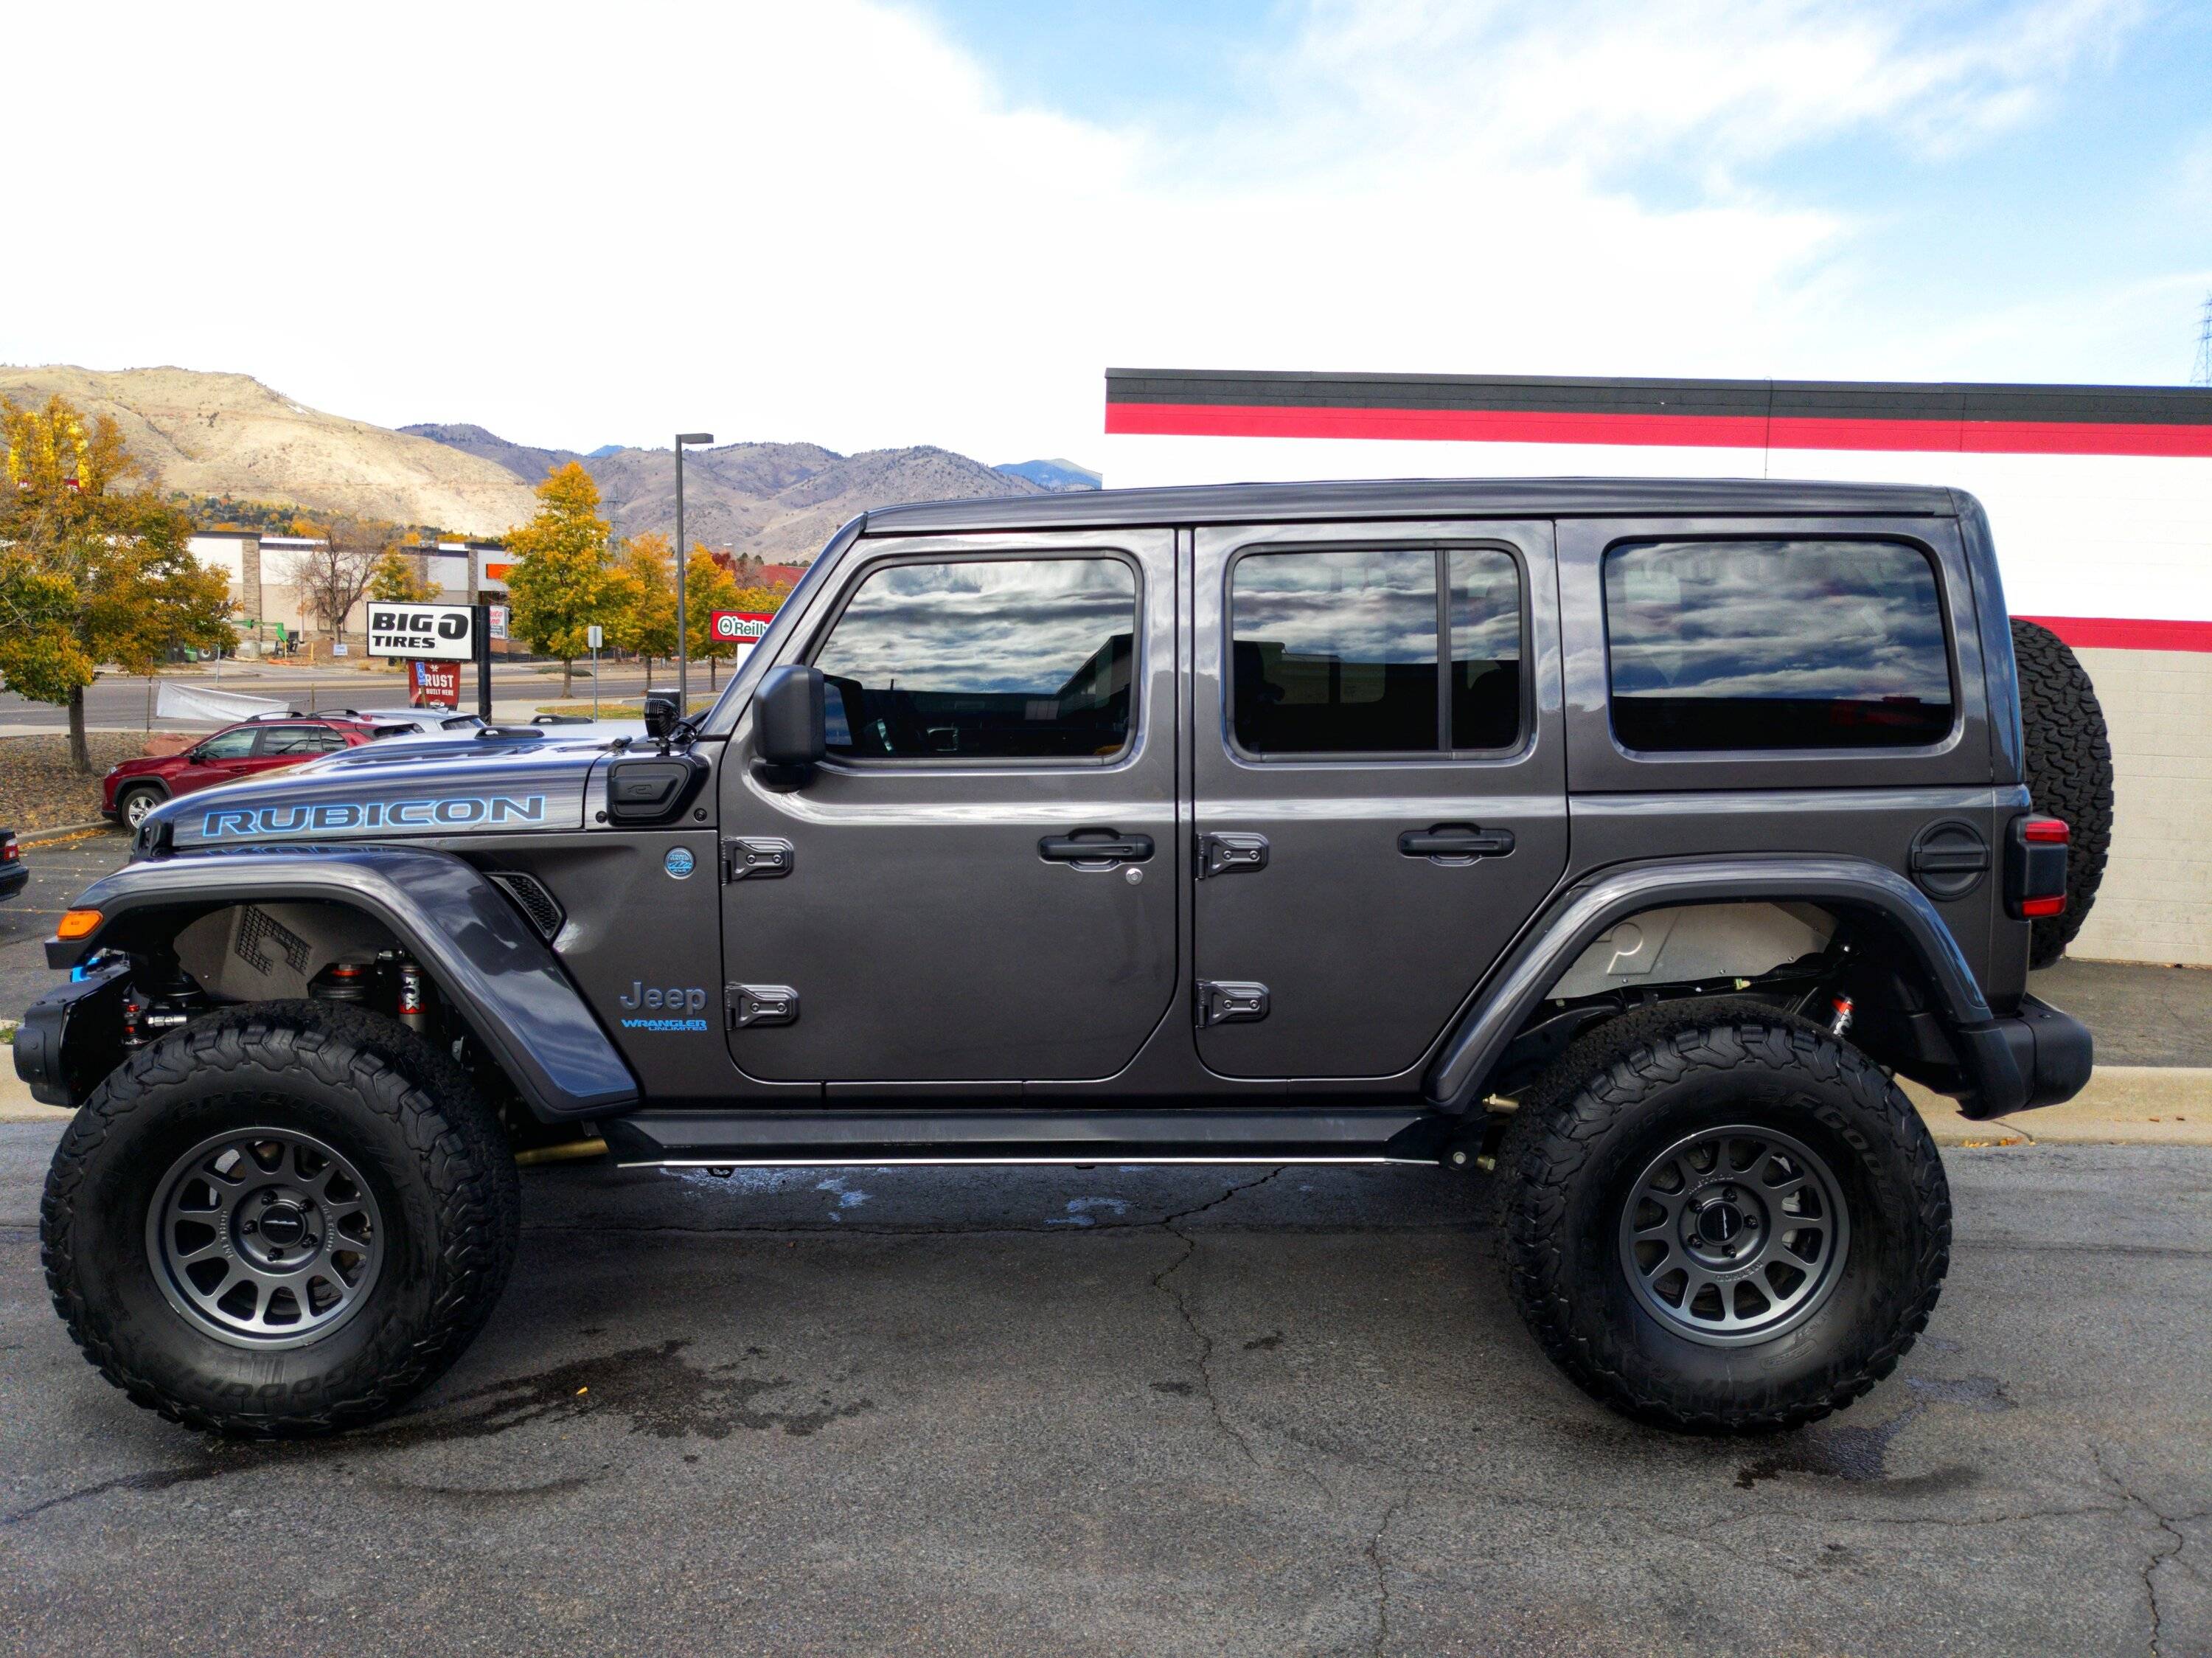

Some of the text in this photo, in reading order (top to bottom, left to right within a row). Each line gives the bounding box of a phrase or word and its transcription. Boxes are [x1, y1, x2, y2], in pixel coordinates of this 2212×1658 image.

[372, 612, 434, 632] BIG
[438, 613, 468, 639] O
[372, 636, 435, 648] TIRES
[425, 673, 454, 688] RUST
[202, 795, 546, 837] RUBICON
[620, 982, 707, 1016] Jeep
[622, 1019, 706, 1027] WRANGLER
